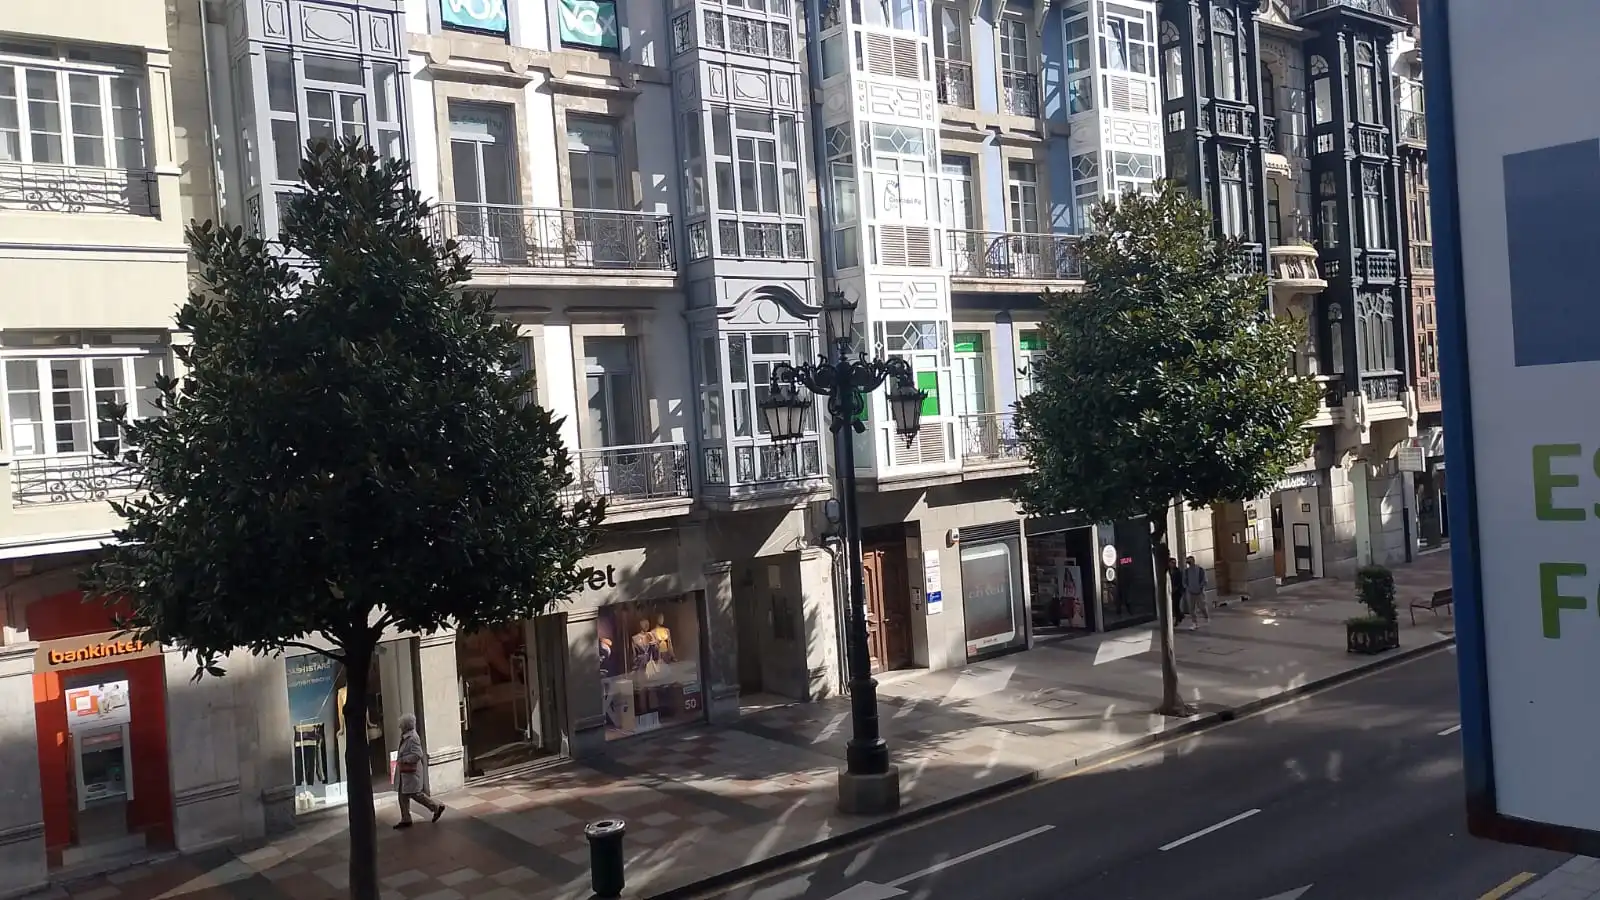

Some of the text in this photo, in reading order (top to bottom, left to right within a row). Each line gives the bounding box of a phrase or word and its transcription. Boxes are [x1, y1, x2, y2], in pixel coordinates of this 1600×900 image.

[1532, 443, 1600, 520] E
[1539, 562, 1600, 640] F
[49, 637, 144, 665] bankinter
